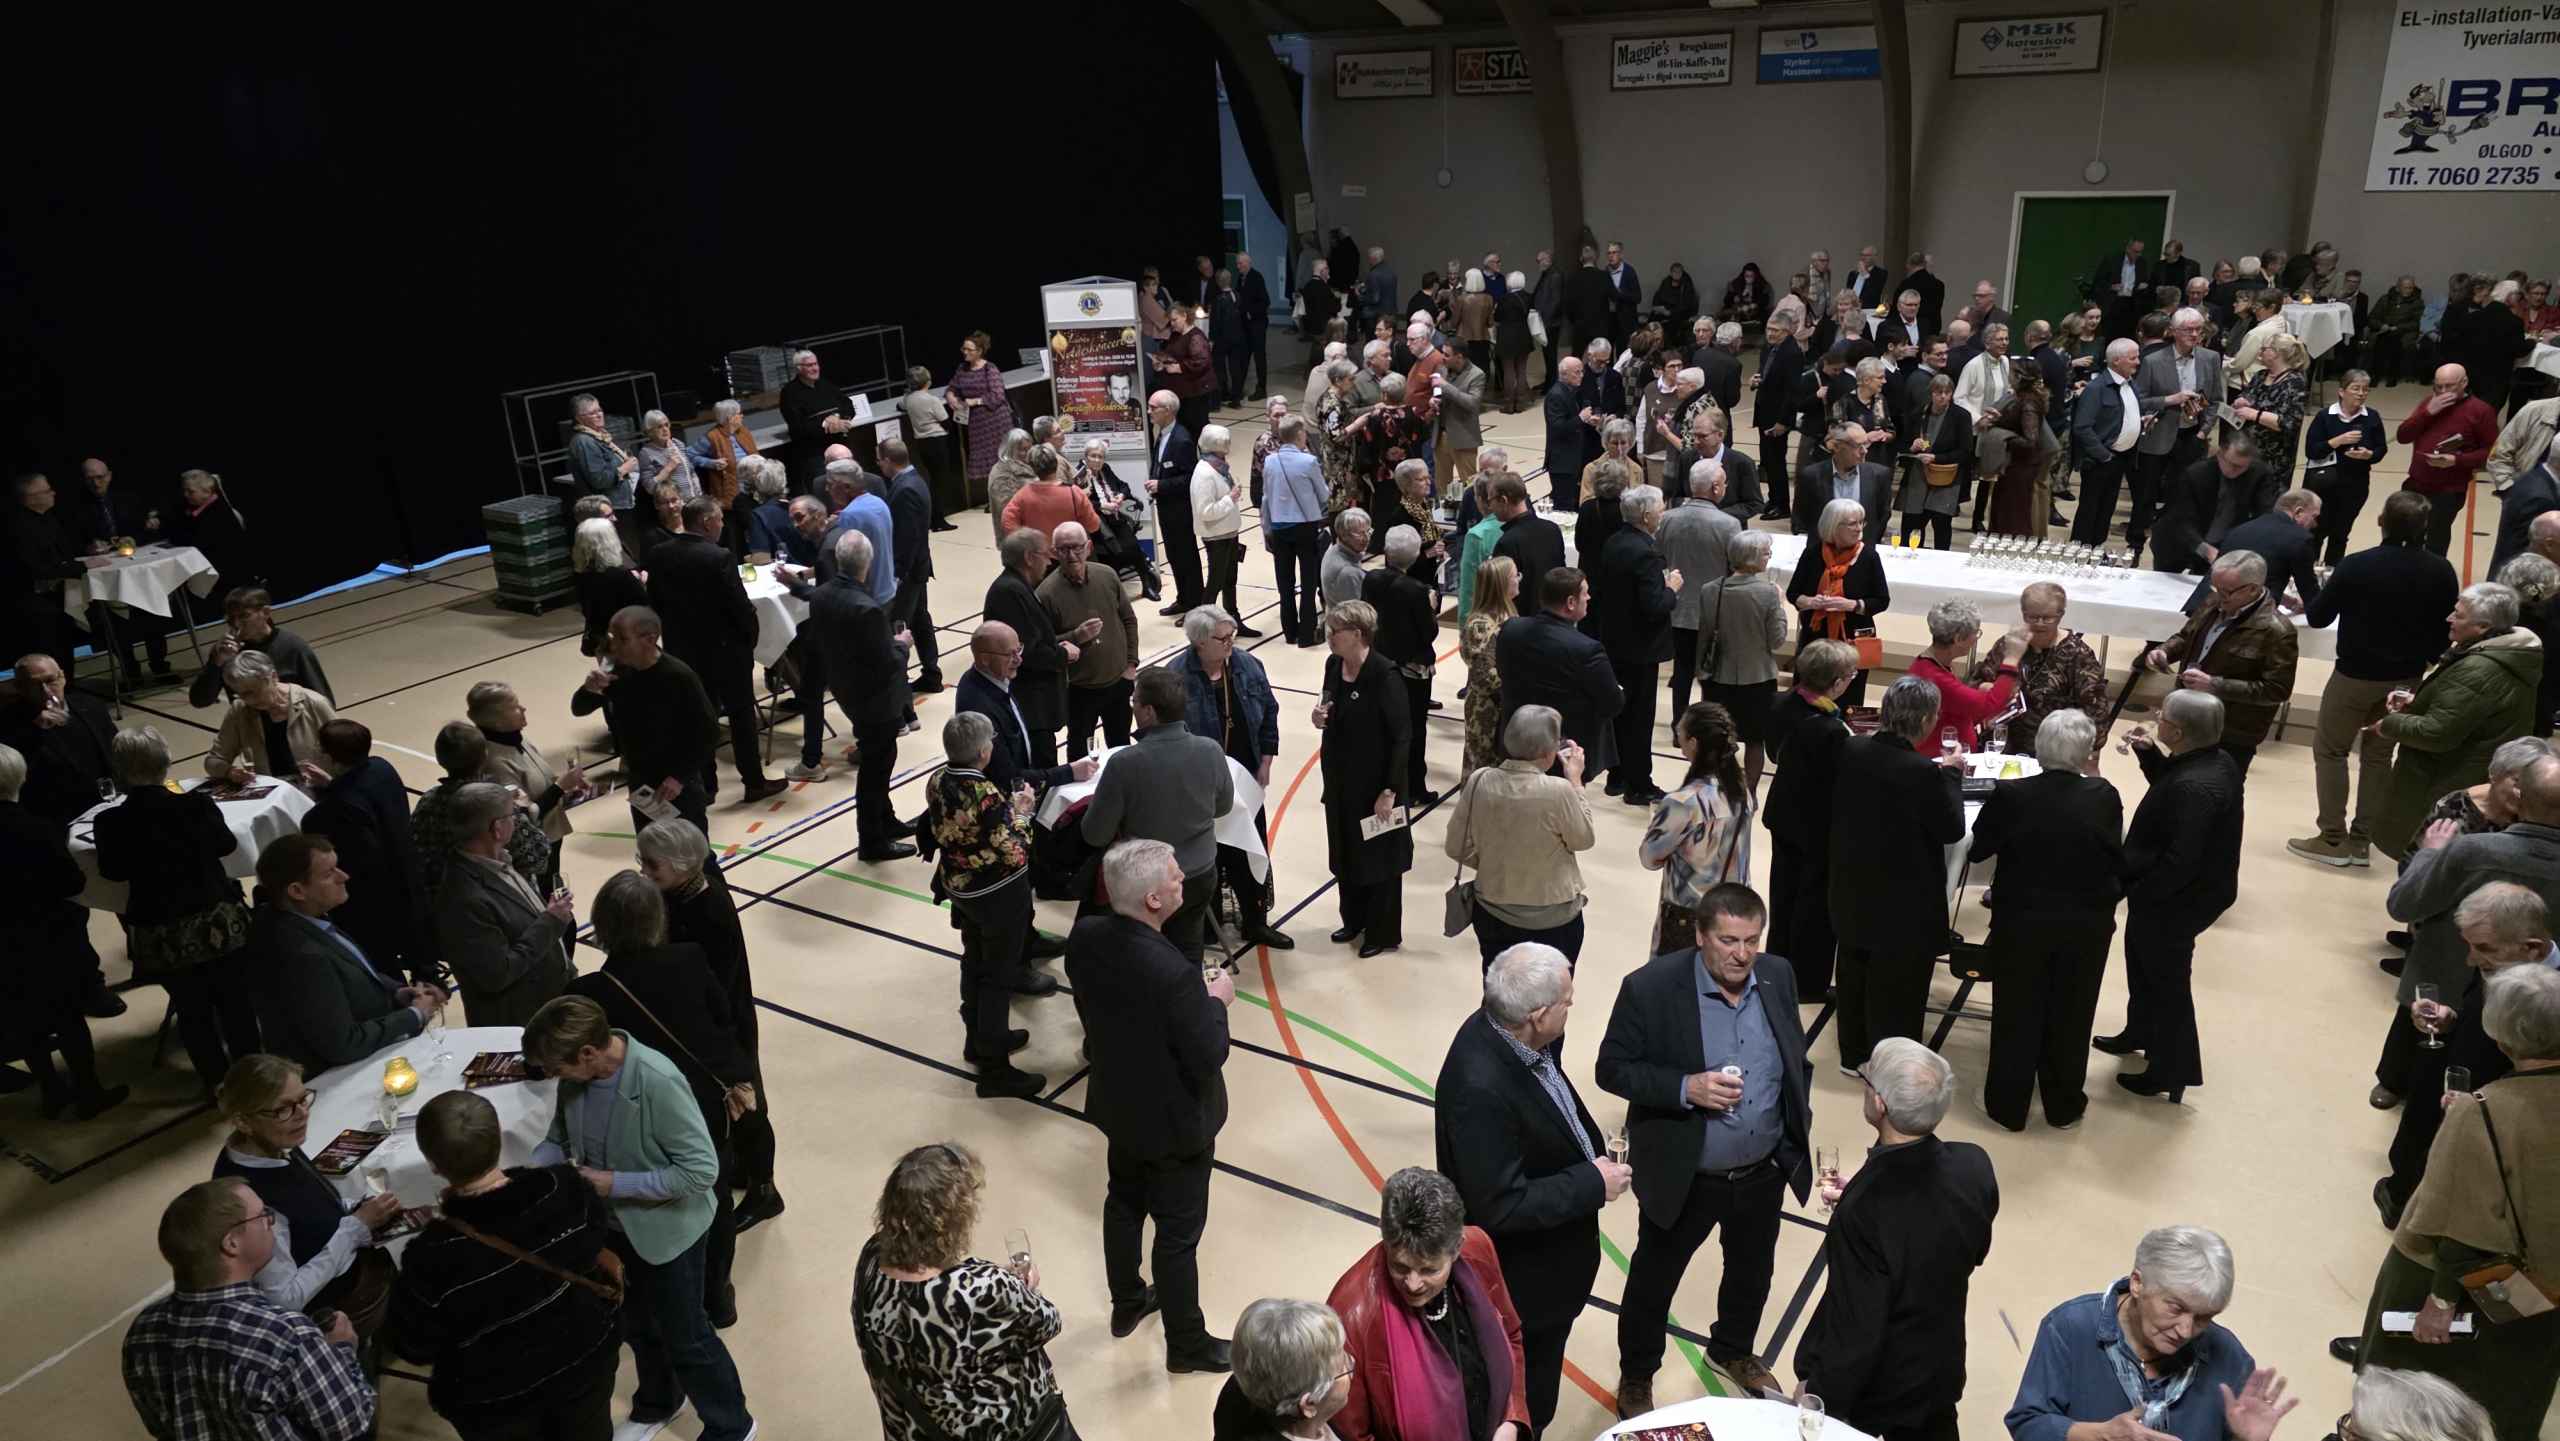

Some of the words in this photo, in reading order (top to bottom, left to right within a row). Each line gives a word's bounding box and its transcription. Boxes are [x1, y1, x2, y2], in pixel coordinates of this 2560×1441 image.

[2007, 23, 2076, 37] M&K
[1617, 40, 1670, 66] Maggie's
[1488, 52, 1529, 79] STA
[2446, 77, 2560, 117] BR
[2479, 144, 2533, 158] ØLGOD
[2388, 168, 2418, 185] Tlf.
[2428, 167, 2479, 185] 7060
[2485, 166, 2540, 185] 2735
